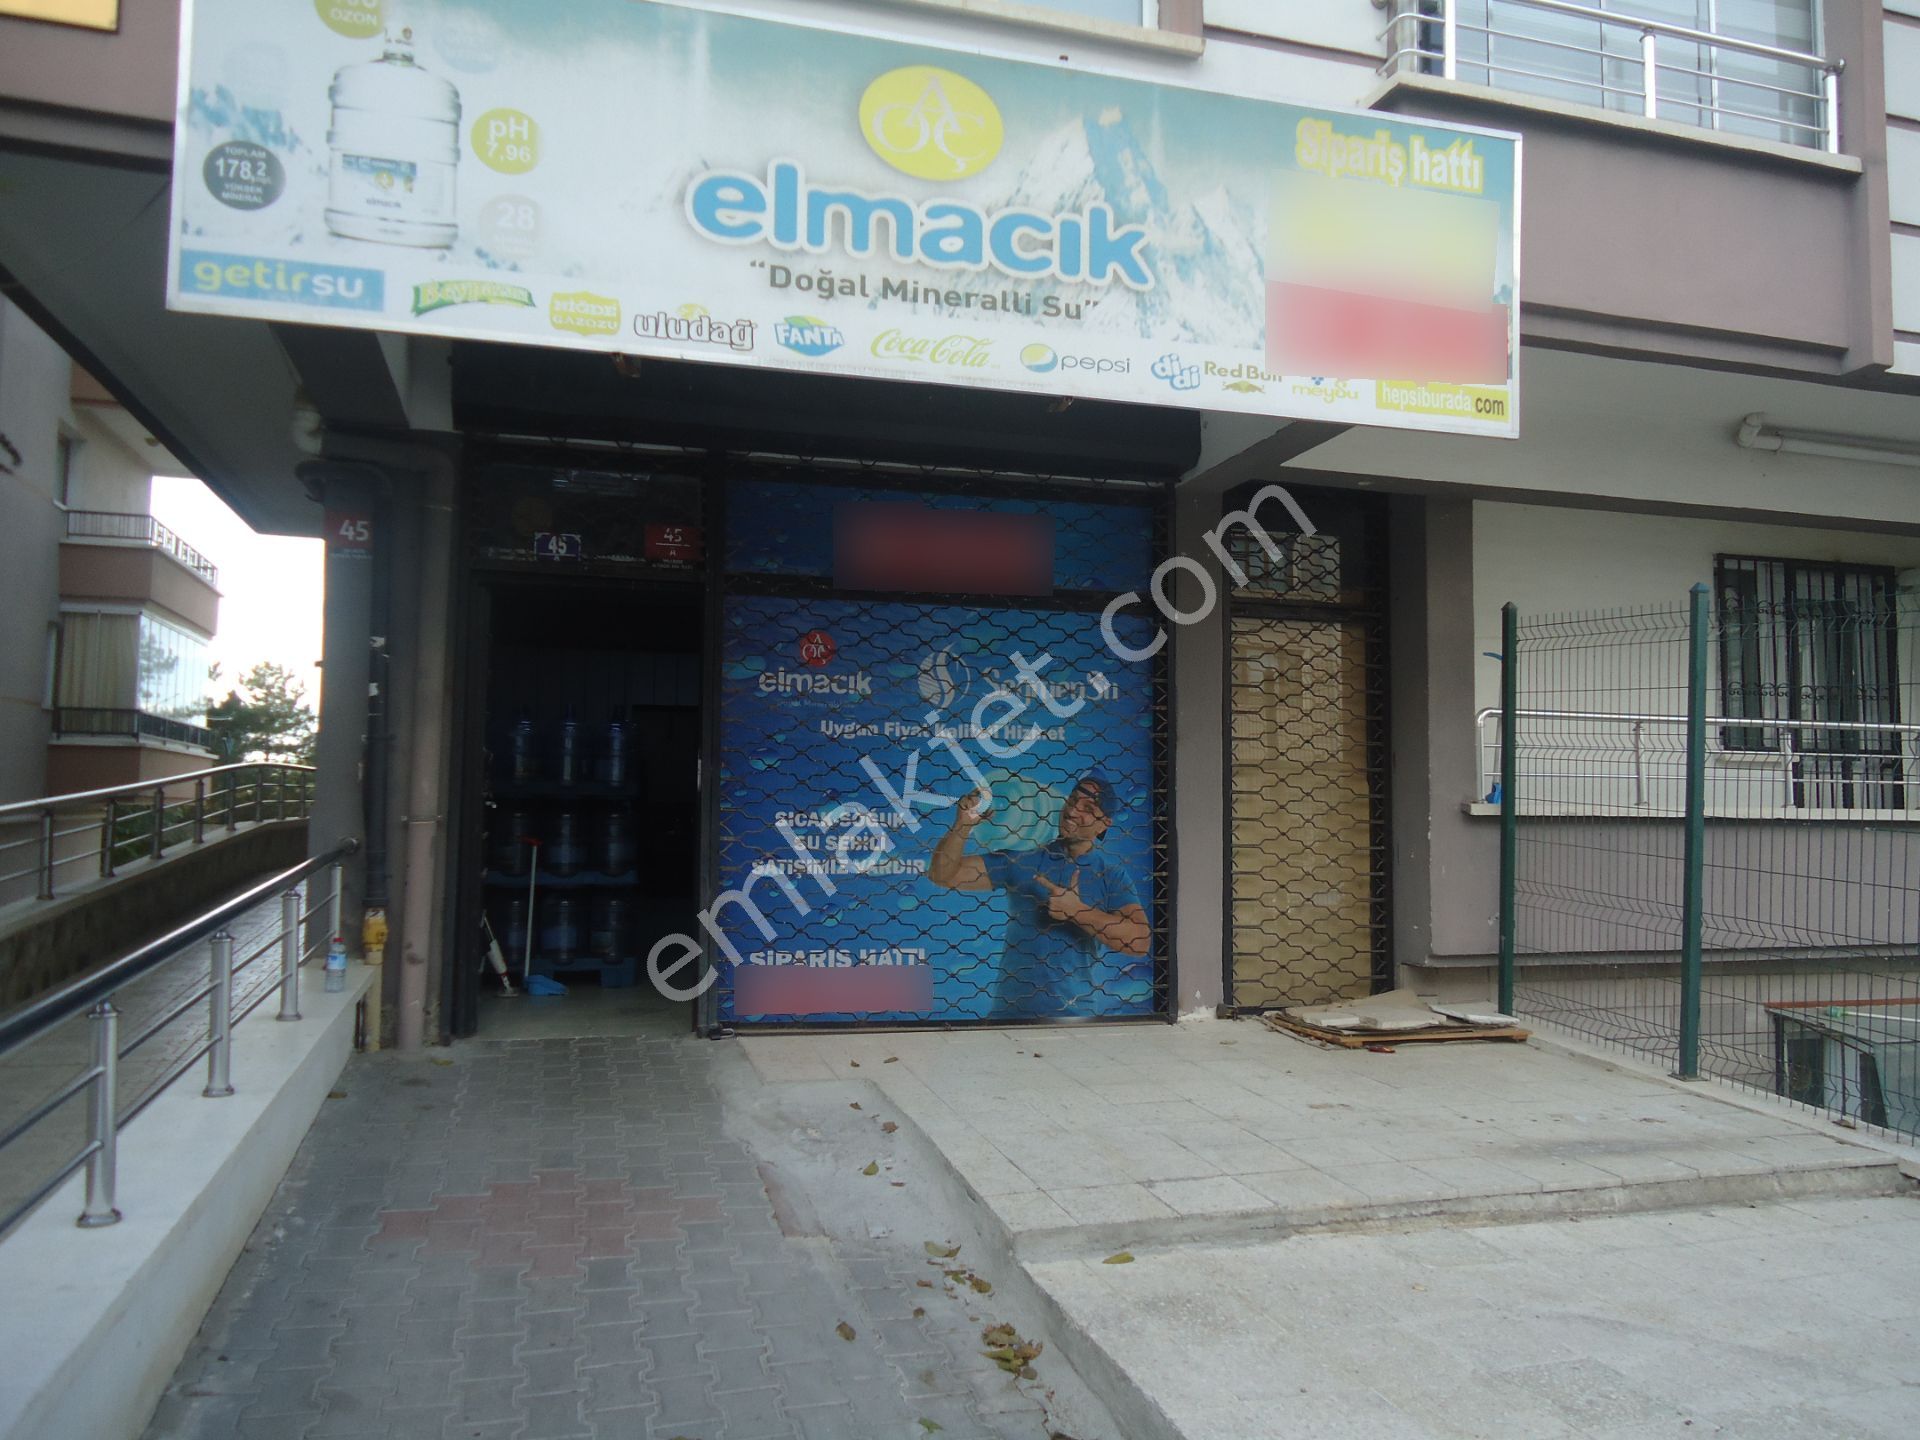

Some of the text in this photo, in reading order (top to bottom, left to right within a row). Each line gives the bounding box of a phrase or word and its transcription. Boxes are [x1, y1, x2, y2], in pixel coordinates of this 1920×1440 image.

[330, 7, 378, 26] OZON
[488, 116, 530, 142] pH
[1298, 117, 1405, 186] Sipariş
[688, 161, 1152, 287] elmacık
[881, 277, 1032, 318] Mineralli
[633, 312, 757, 352] uludağ
[1060, 357, 1131, 374] pepsi
[1204, 360, 1243, 379] Red
[339, 519, 369, 542] 45
[663, 527, 682, 543] 45
[548, 535, 567, 555] 45
[820, 719, 879, 740] Uygun
[884, 721, 928, 741] Fiyat
